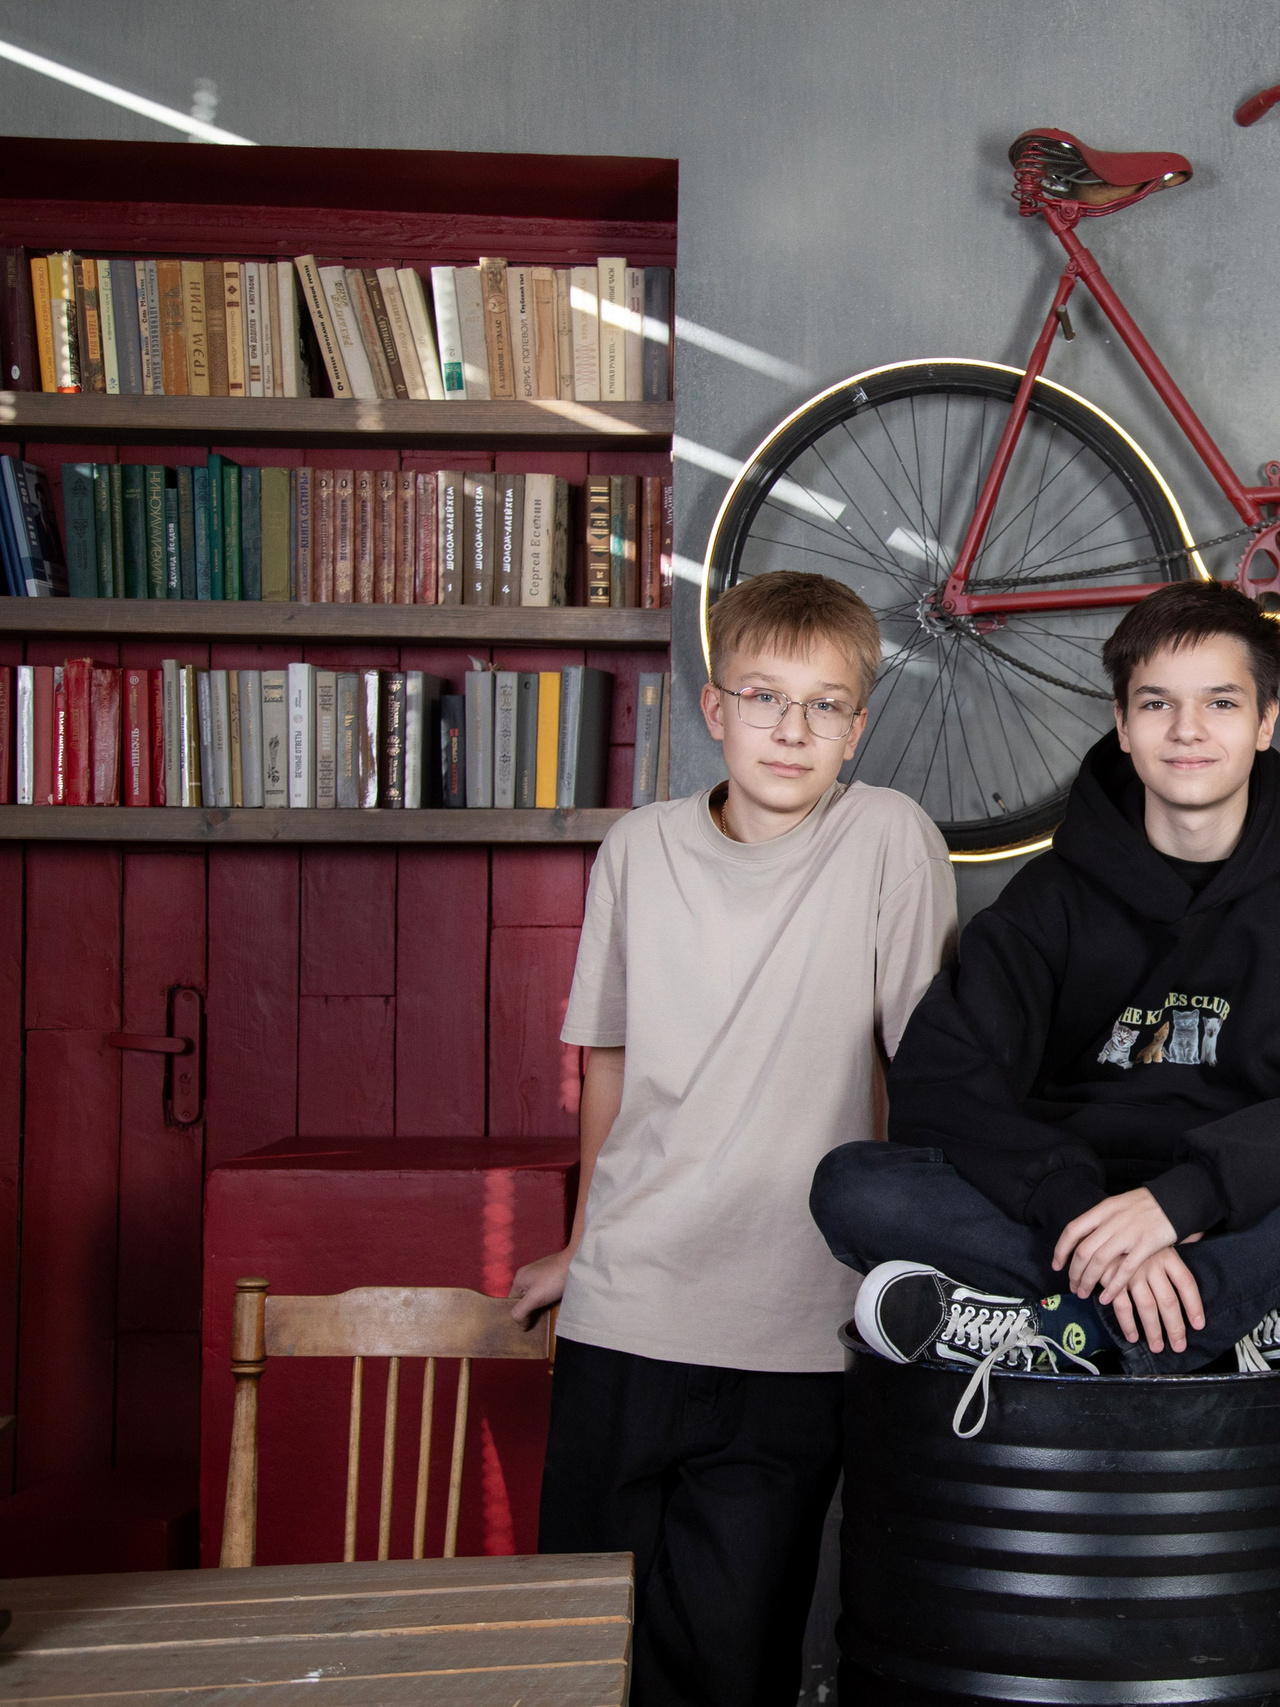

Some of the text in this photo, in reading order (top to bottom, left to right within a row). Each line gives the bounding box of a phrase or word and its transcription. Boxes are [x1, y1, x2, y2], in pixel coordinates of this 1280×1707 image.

[189, 281, 206, 377] ГРЭМ ГРИН
[520, 318, 530, 363] ПОЛЕВОЙ
[523, 366, 532, 397] БОРИС
[18, 473, 29, 504] 2011
[150, 471, 162, 530] ЛУКОНИН
[445, 486, 454, 571] ШОЛОМ-АЛЕЙХЕМ
[474, 486, 483, 570] ШОЛОМ-АЛЕЙХЕМ
[502, 488, 514, 573] ШОЛОМ-АЛЕЙХЕМ
[528, 499, 542, 596] Сергей Есенин
[168, 523, 177, 588] Эдуард Асадов
[447, 583, 453, 592] 1
[475, 582, 482, 592] 5
[501, 584, 510, 594] 4
[131, 728, 140, 767] ПИКУЛЬ
[294, 730, 302, 754] ОТВЕТЫ
[1191, 996, 1230, 1020] CLUB
